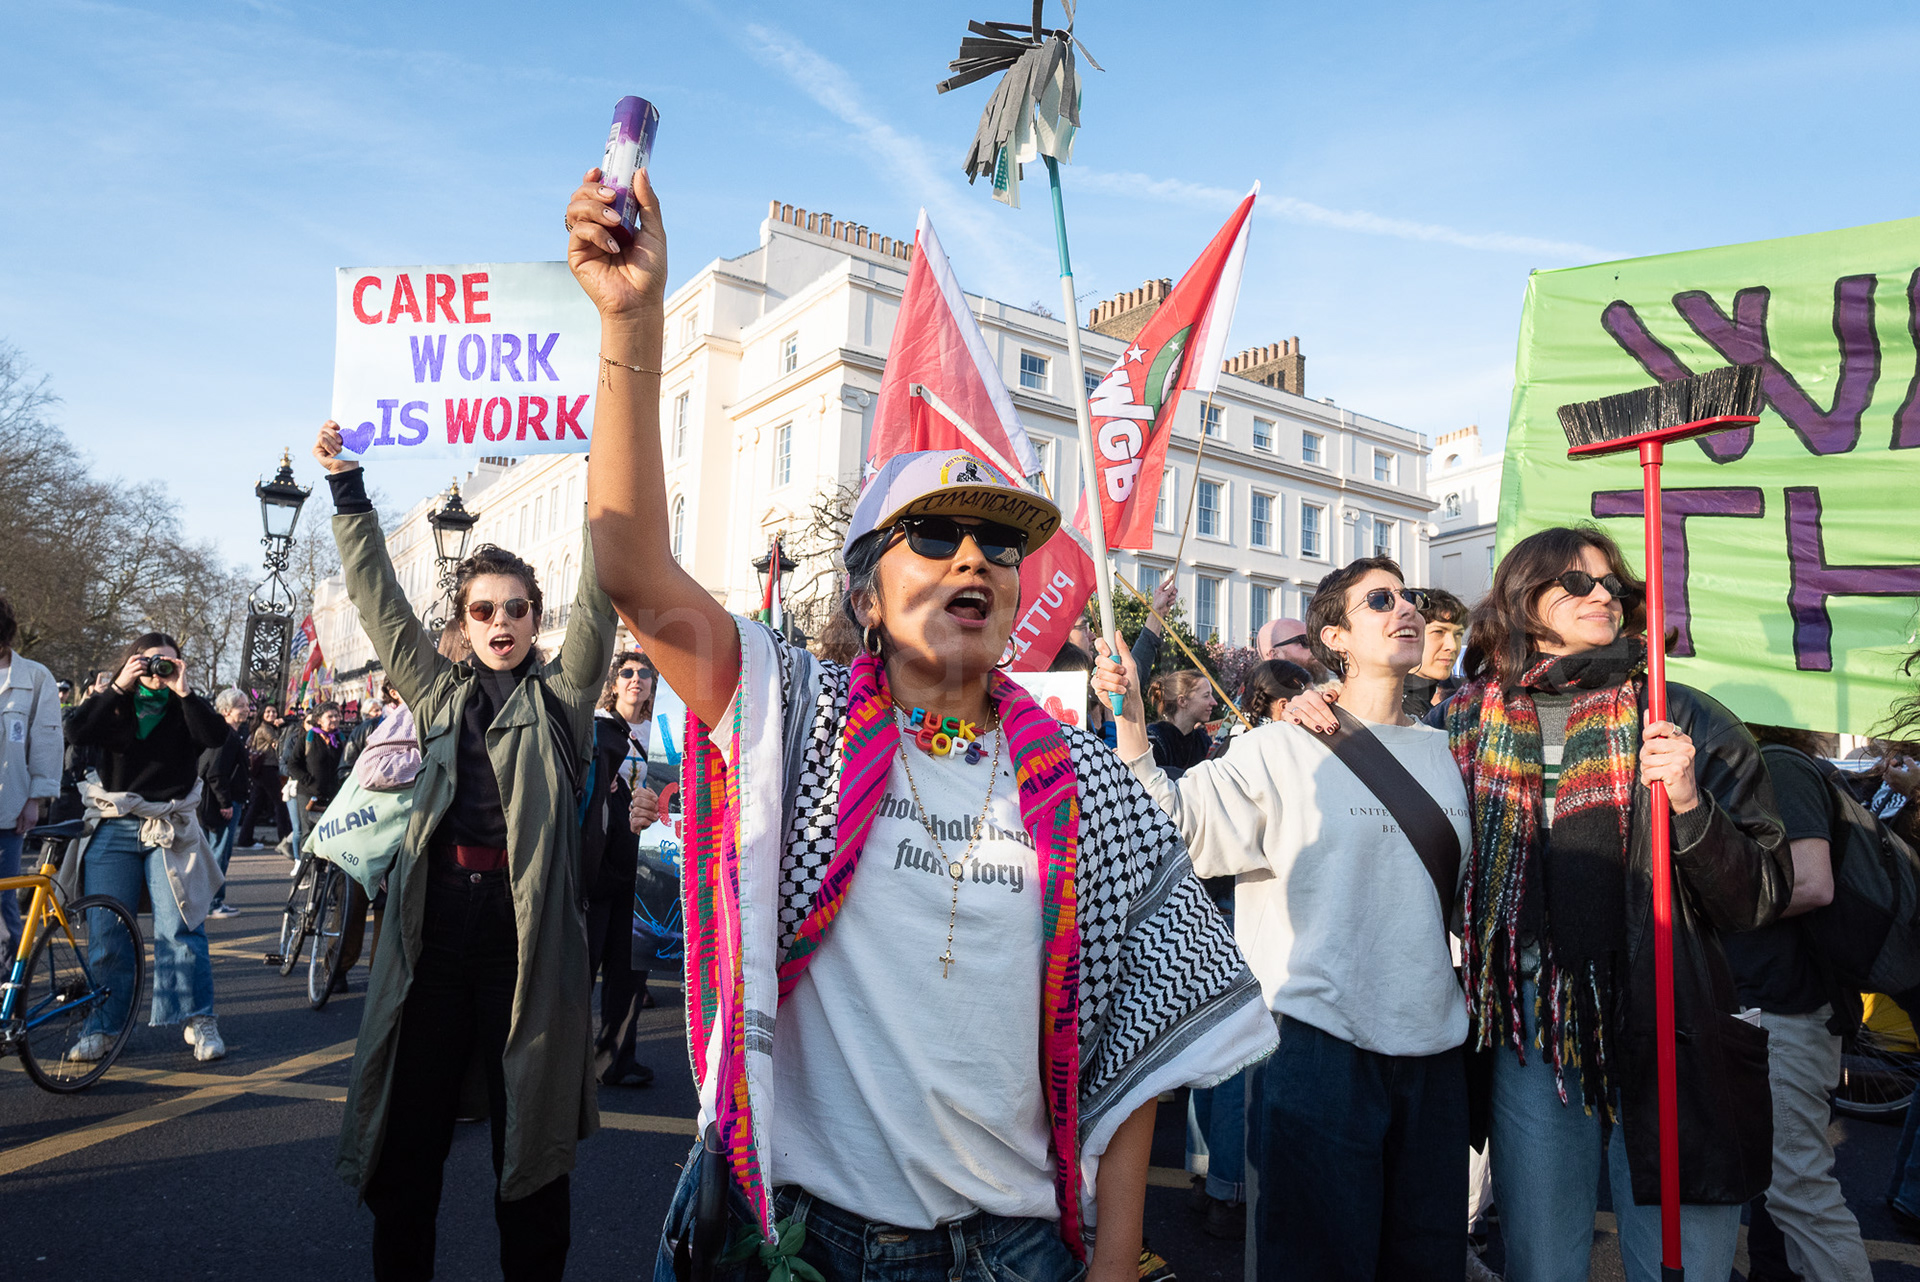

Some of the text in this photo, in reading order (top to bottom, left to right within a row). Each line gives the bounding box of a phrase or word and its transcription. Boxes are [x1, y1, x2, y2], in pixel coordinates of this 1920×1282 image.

[352, 272, 491, 325] CARE
[409, 332, 560, 383] WORK
[373, 394, 590, 446] IS WORK
[910, 707, 976, 742] FUCK
[915, 729, 982, 765] COPS
[318, 805, 377, 842] MILAN
[1350, 807, 1392, 817] UNITE
[341, 851, 359, 866] 430
[970, 857, 1024, 893] tory
